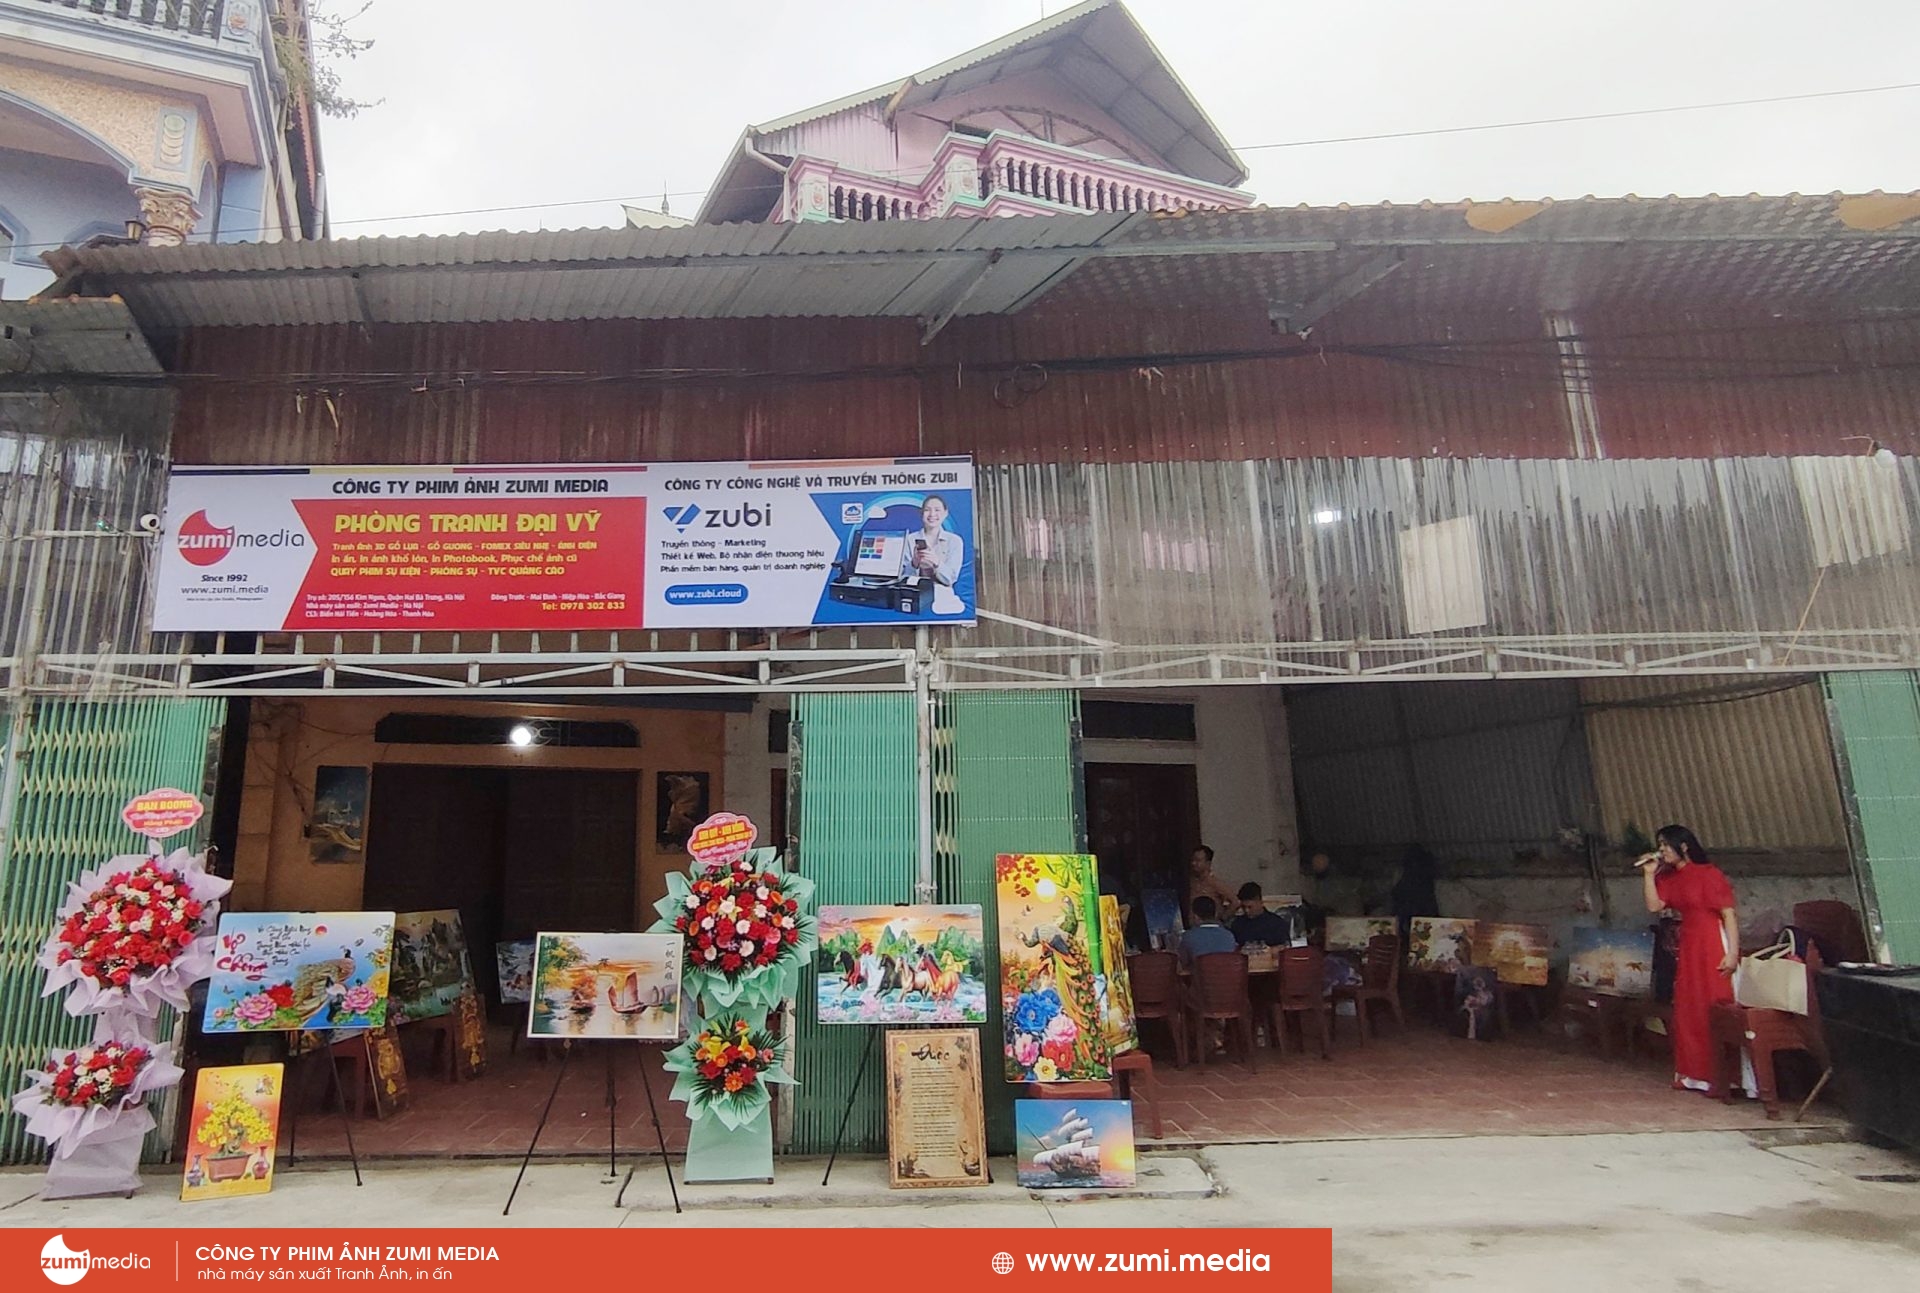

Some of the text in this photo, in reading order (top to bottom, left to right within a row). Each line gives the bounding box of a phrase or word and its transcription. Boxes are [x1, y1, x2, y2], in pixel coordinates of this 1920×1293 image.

[332, 476, 608, 494] CÔNG TY PHIM ẢNH ZUMI MEDIA
[664, 478, 701, 490] CÔNG
[705, 479, 721, 490] TY
[727, 476, 763, 489] CÔNG
[767, 475, 801, 491] NGHỆ
[805, 474, 822, 487] VÀ
[881, 472, 925, 485] THÔNG
[930, 472, 958, 484] ZUBI
[705, 502, 771, 528] zubi
[335, 510, 421, 533] PHÒNG
[429, 513, 508, 533] TRANH
[516, 513, 557, 537] ĐẠI
[724, 539, 766, 547] Marketing
[331, 566, 357, 577] QUAY
[488, 566, 507, 576] TVC
[774, 562, 798, 570] doanh
[201, 574, 248, 582] Since 1992
[181, 585, 269, 594] www.zumi.media
[669, 588, 742, 600] www.zubi.cloud
[541, 602, 557, 610] Tel:
[560, 602, 584, 610] 0978
[587, 602, 604, 610] 302
